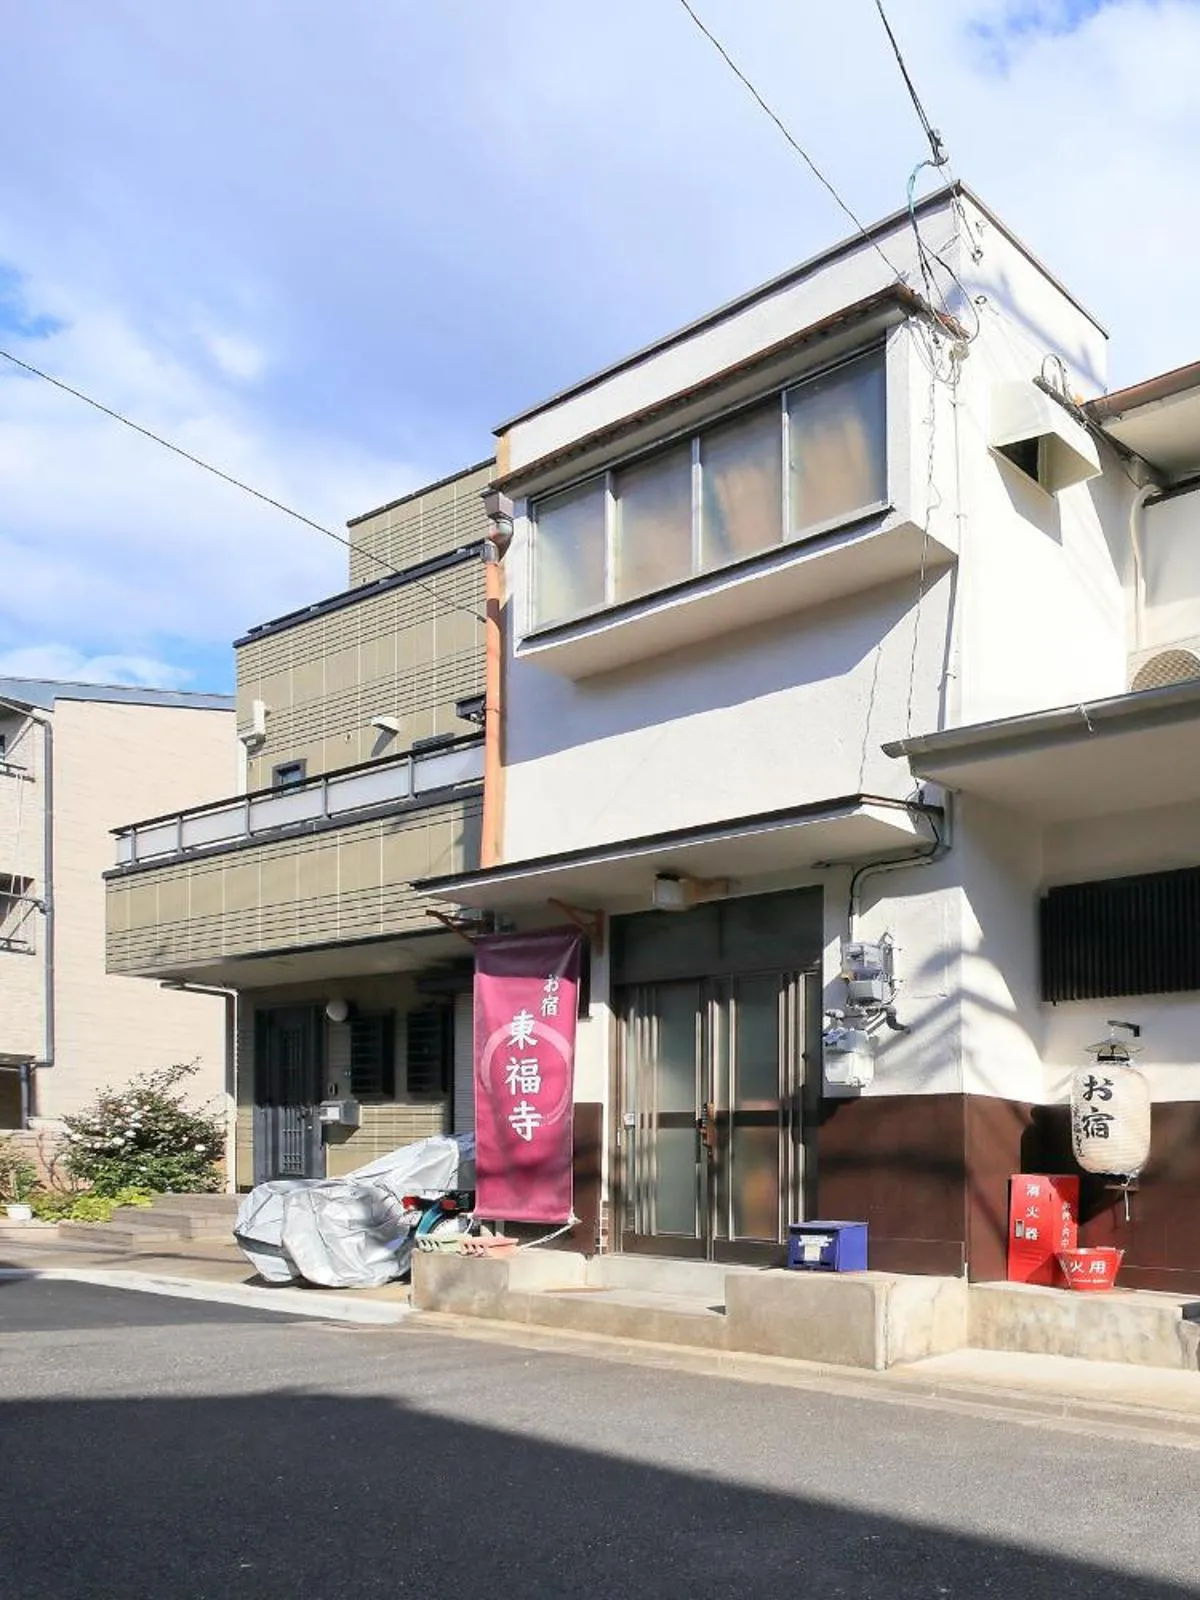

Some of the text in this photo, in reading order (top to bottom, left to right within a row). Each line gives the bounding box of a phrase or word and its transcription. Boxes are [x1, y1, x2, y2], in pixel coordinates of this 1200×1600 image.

[541, 974, 560, 1017] お宿
[505, 1009, 543, 1142] 東福寺
[1082, 1074, 1115, 1139] お宿
